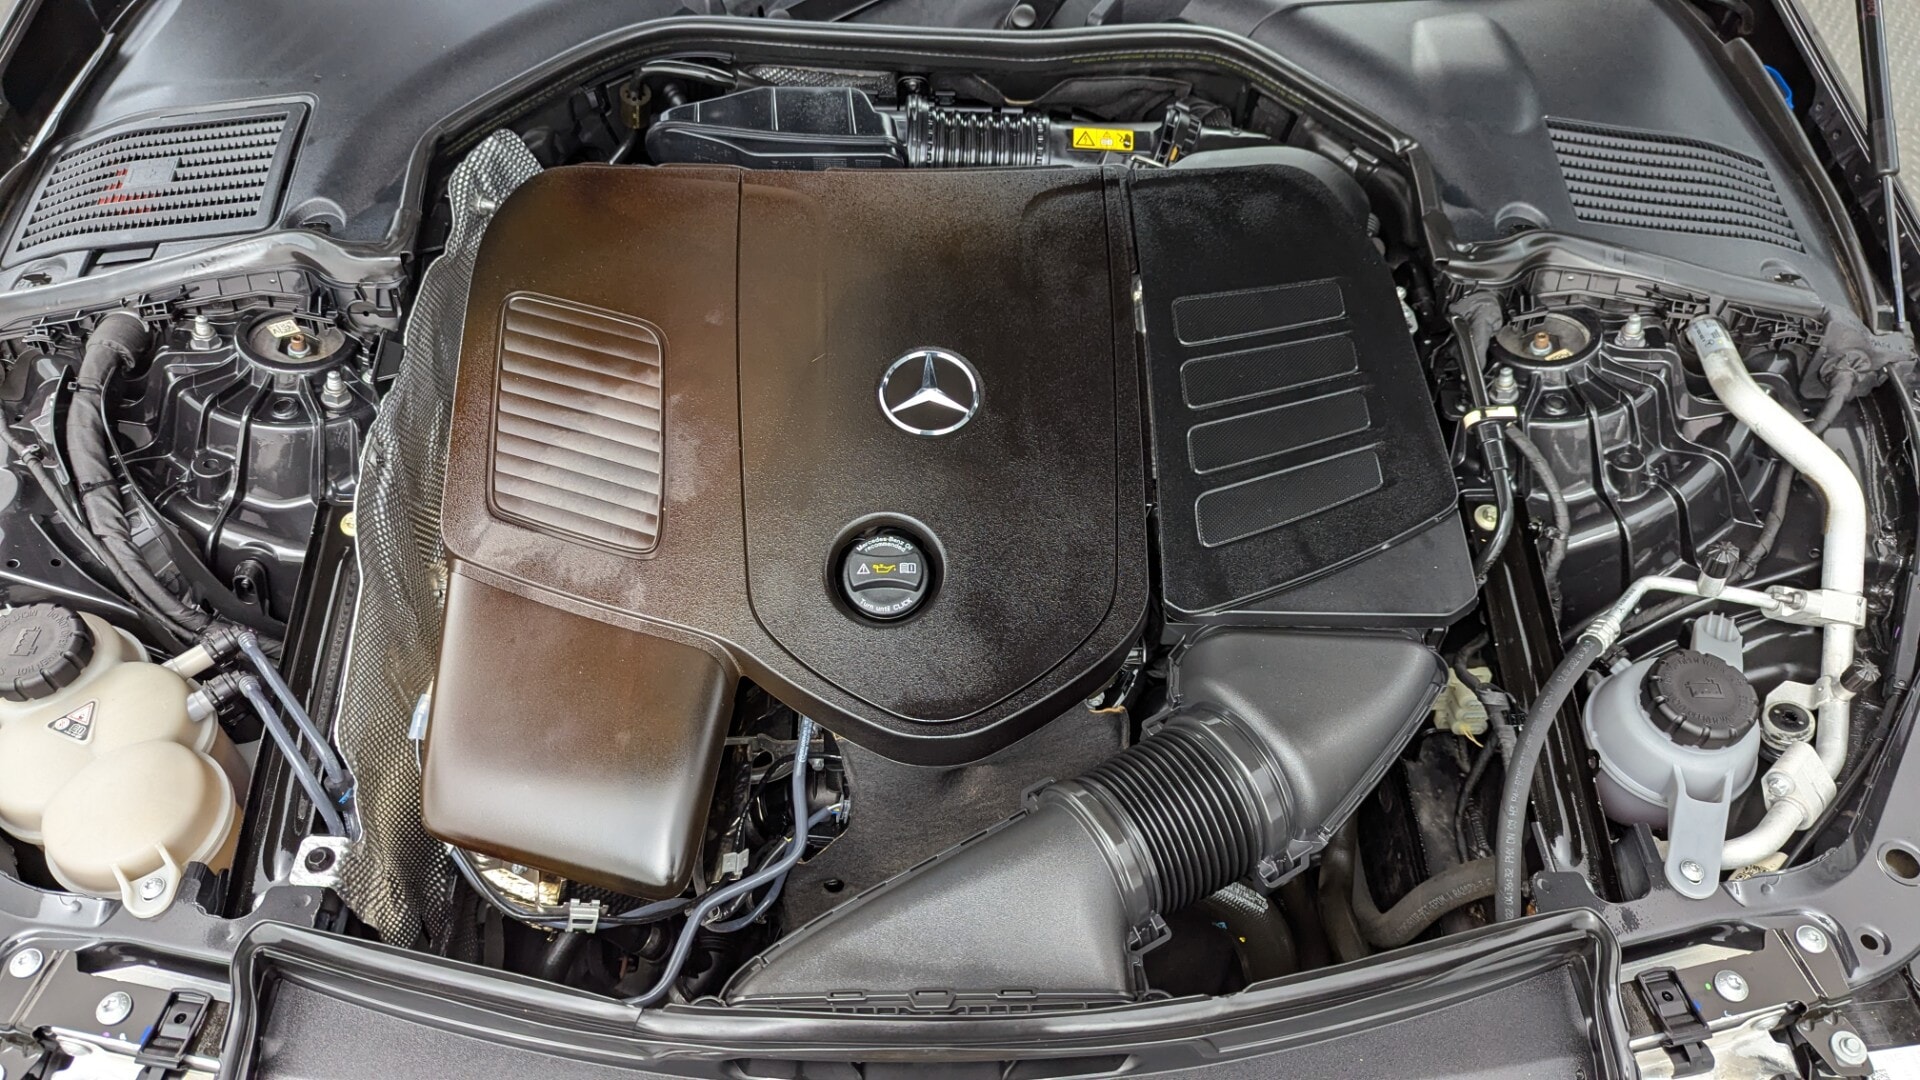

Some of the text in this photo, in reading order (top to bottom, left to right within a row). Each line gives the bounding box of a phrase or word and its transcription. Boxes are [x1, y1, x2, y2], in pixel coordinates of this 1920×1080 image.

[864, 542, 907, 553] recommended
[860, 597, 913, 613] Turn until CLICK
